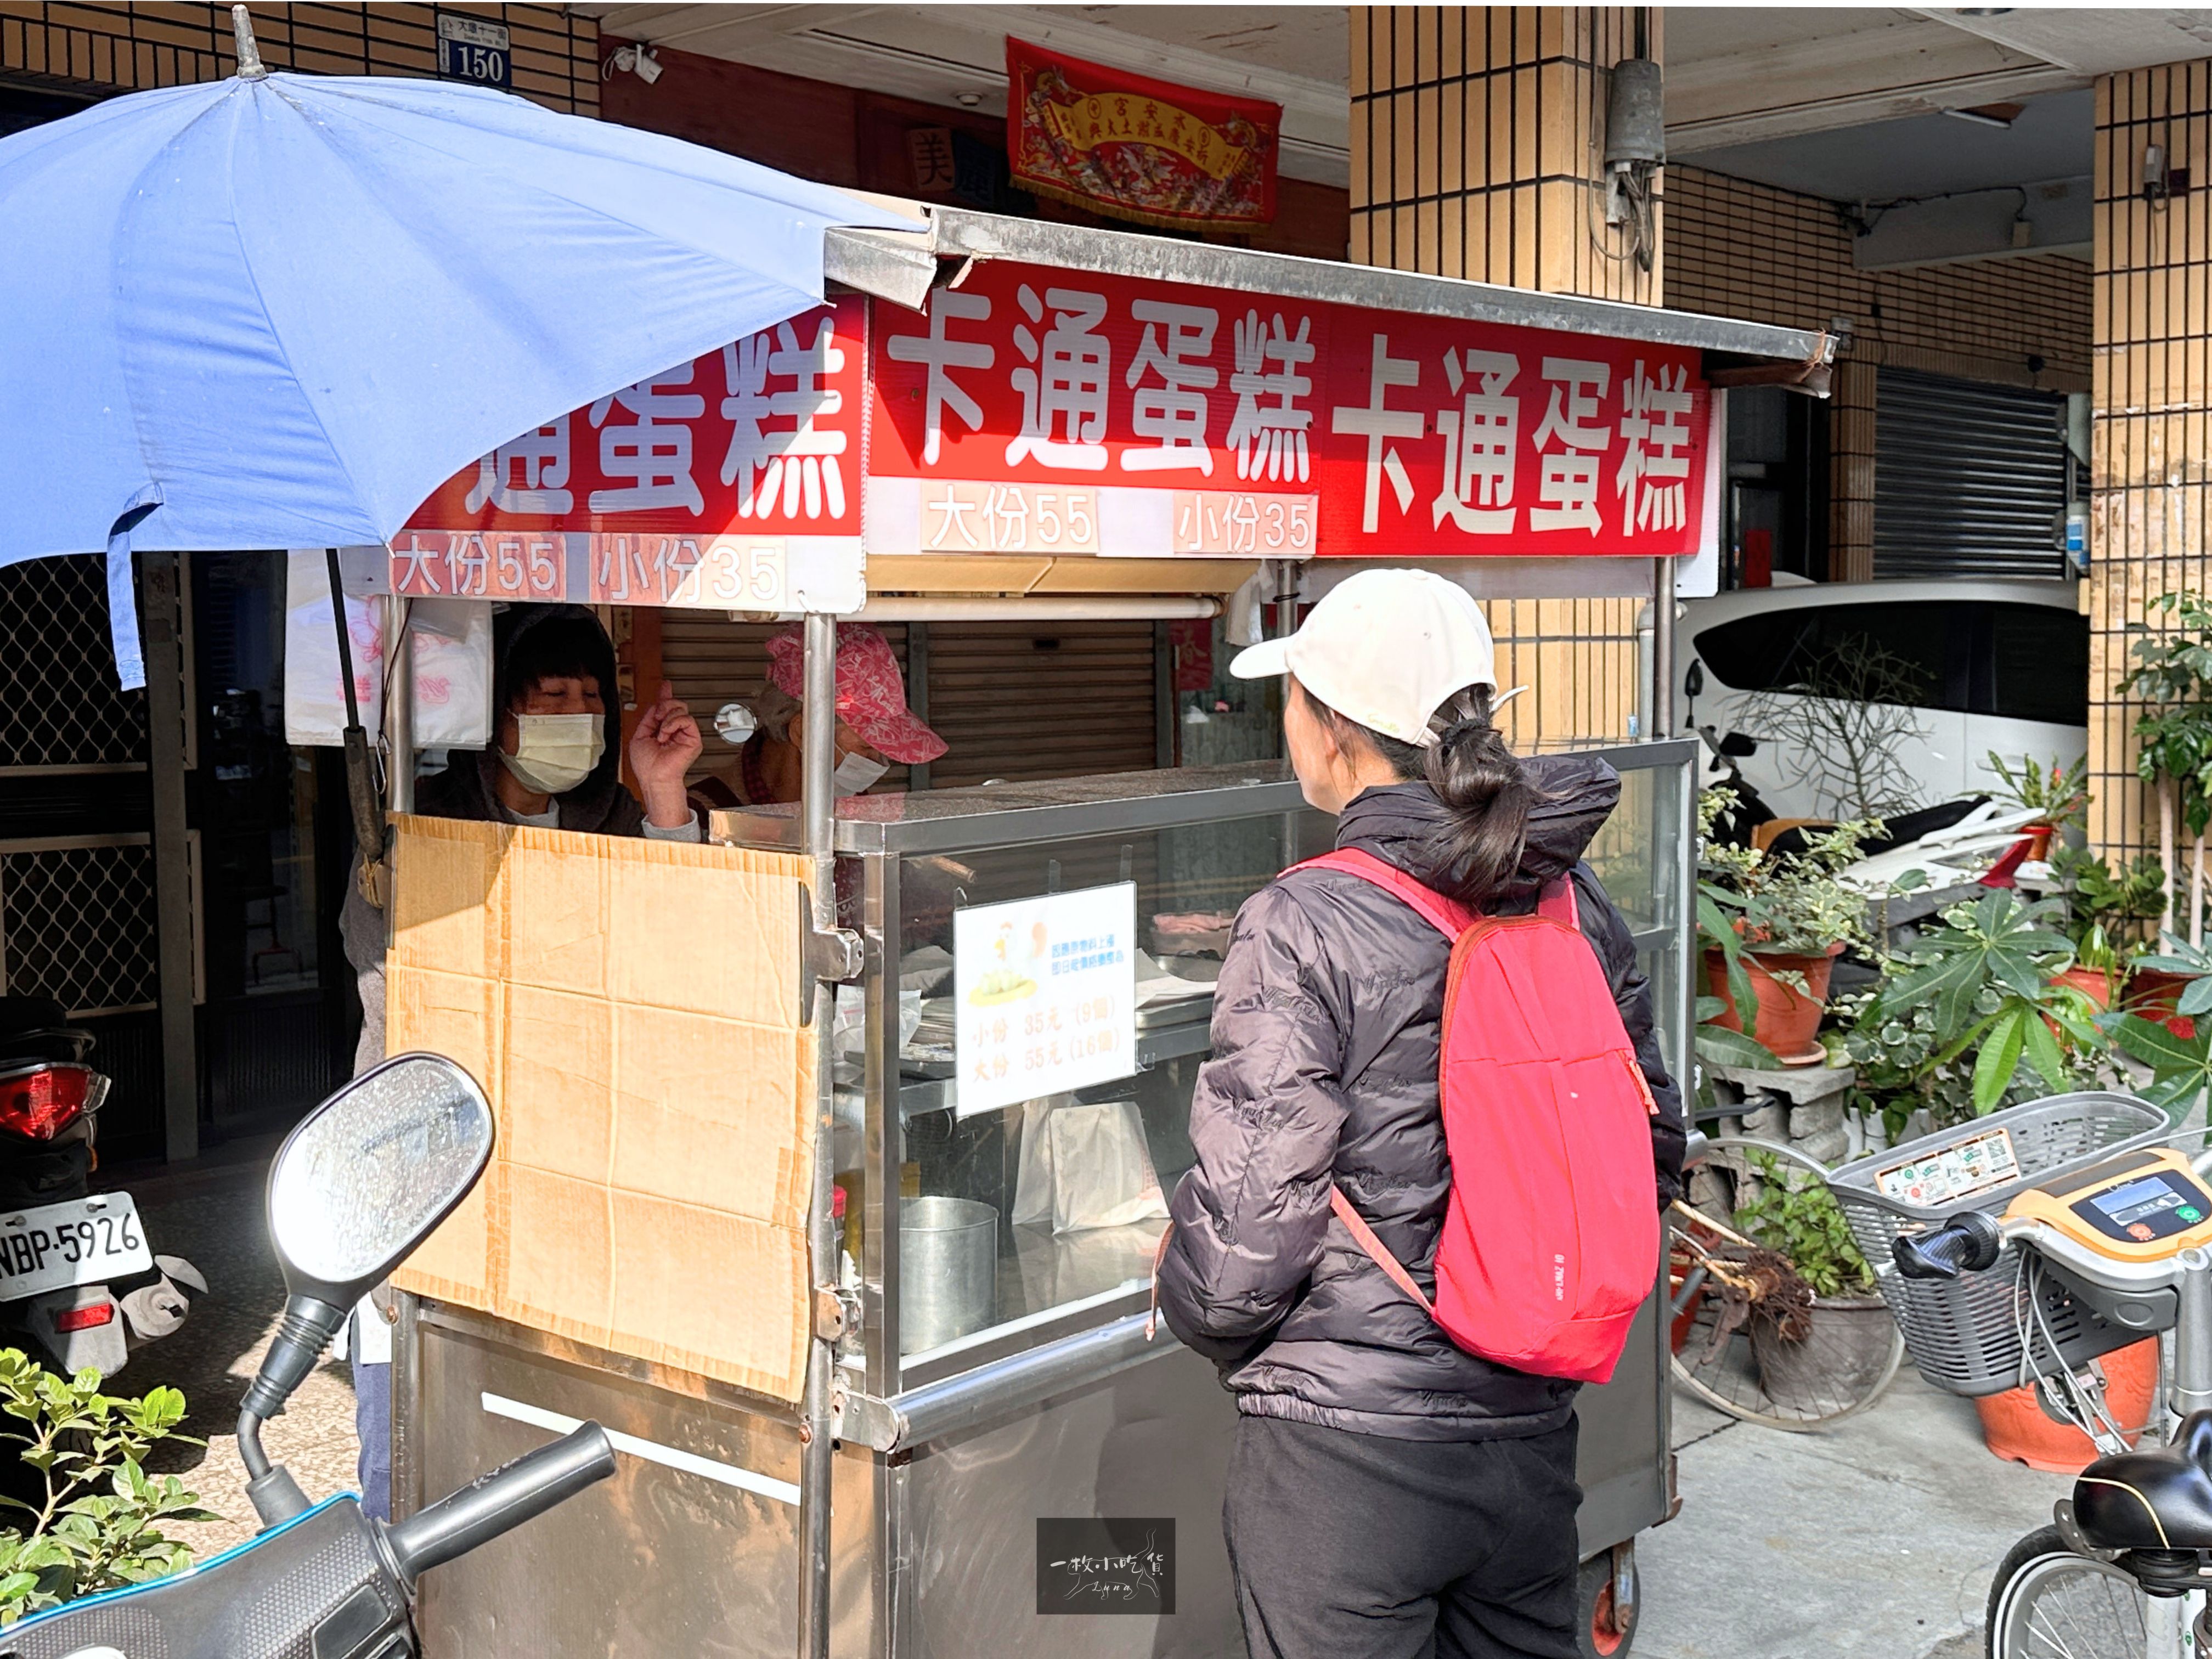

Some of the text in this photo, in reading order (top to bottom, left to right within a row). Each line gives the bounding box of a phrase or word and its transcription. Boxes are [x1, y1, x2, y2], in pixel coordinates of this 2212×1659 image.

[458, 47, 503, 82] 150
[888, 284, 1317, 483] 卡通蛋糕
[1332, 333, 1694, 539] 卡通蛋糕
[928, 485, 1093, 550] 大份55
[1178, 493, 1310, 554] 小份35
[396, 535, 554, 595] 大份55
[599, 538, 780, 603] 小份35
